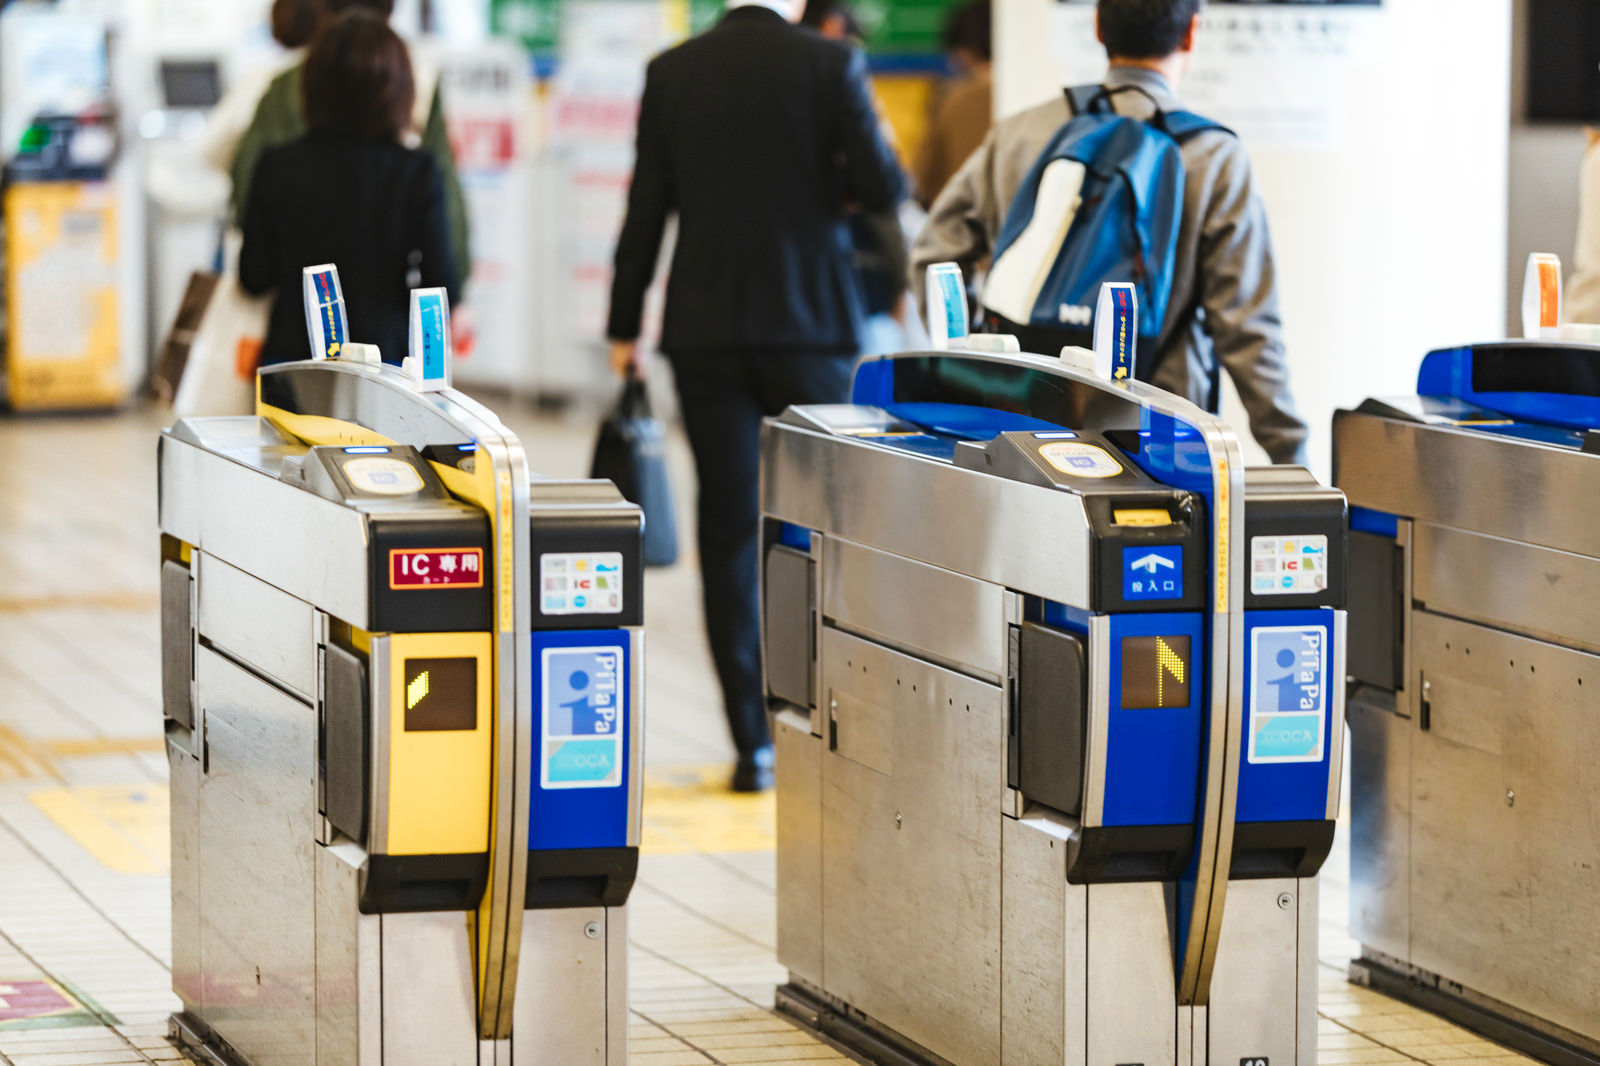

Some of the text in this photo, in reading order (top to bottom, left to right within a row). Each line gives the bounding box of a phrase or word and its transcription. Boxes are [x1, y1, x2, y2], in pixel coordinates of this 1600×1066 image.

[402, 553, 478, 576] IC 専用
[1131, 579, 1175, 593] 投入口
[594, 654, 617, 734] PiTaPa
[1299, 633, 1321, 710] PiTaPa
